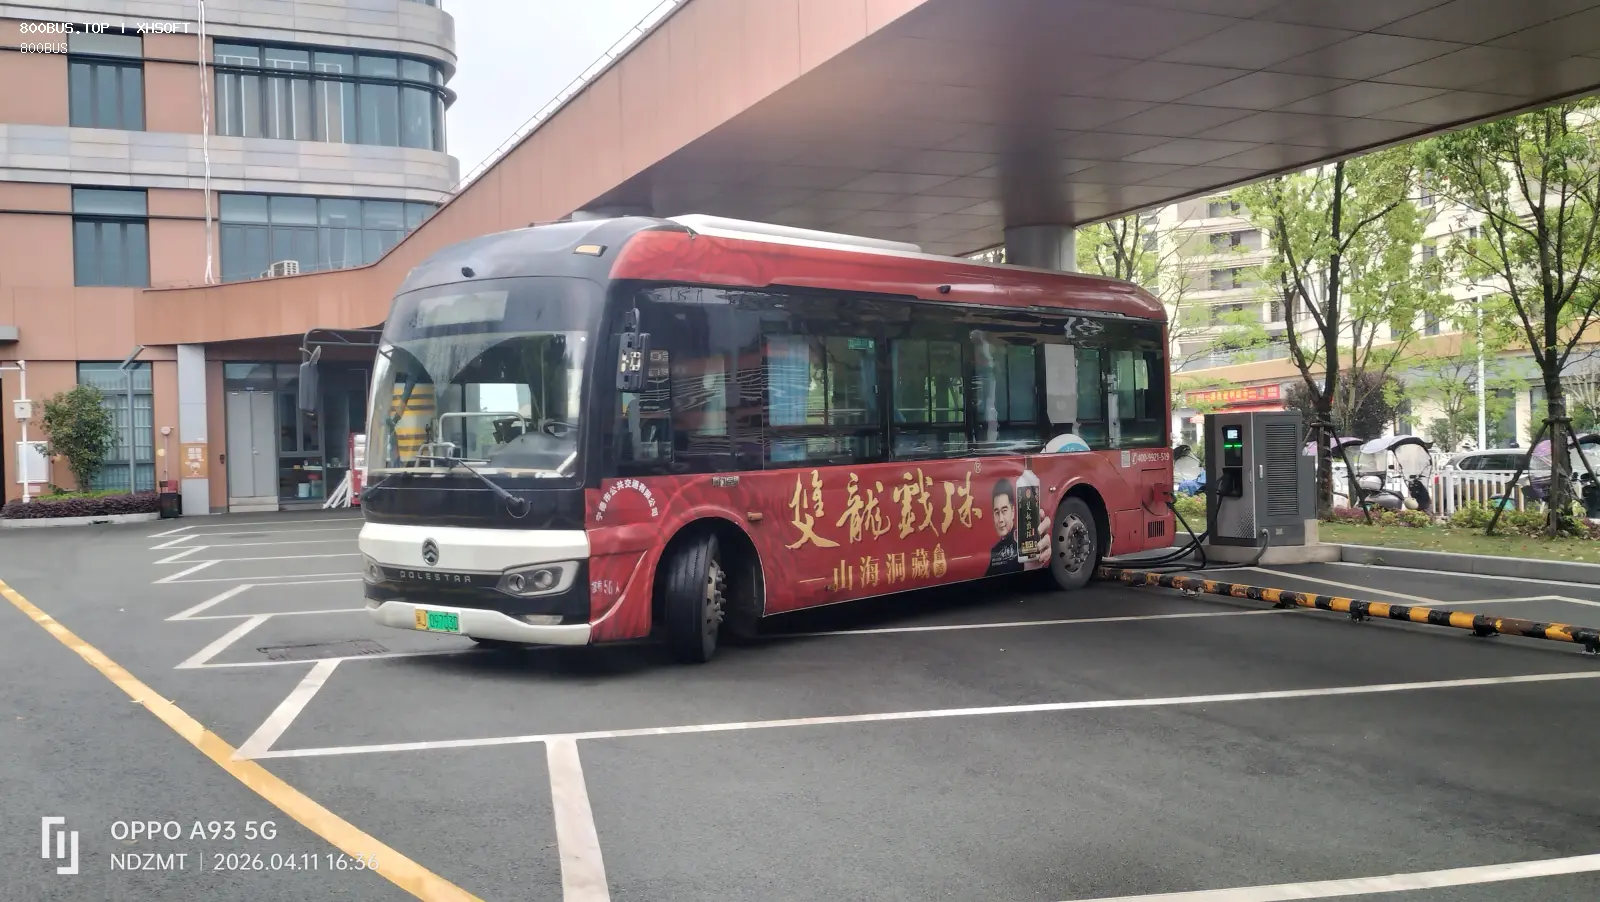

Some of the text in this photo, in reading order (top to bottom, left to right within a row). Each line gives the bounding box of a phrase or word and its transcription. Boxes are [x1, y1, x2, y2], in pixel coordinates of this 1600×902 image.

[595, 478, 659, 522] 宁德市公共交通有限公司
[400, 570, 472, 583] POLESTAR
[832, 548, 930, 593] 山海洞藏
